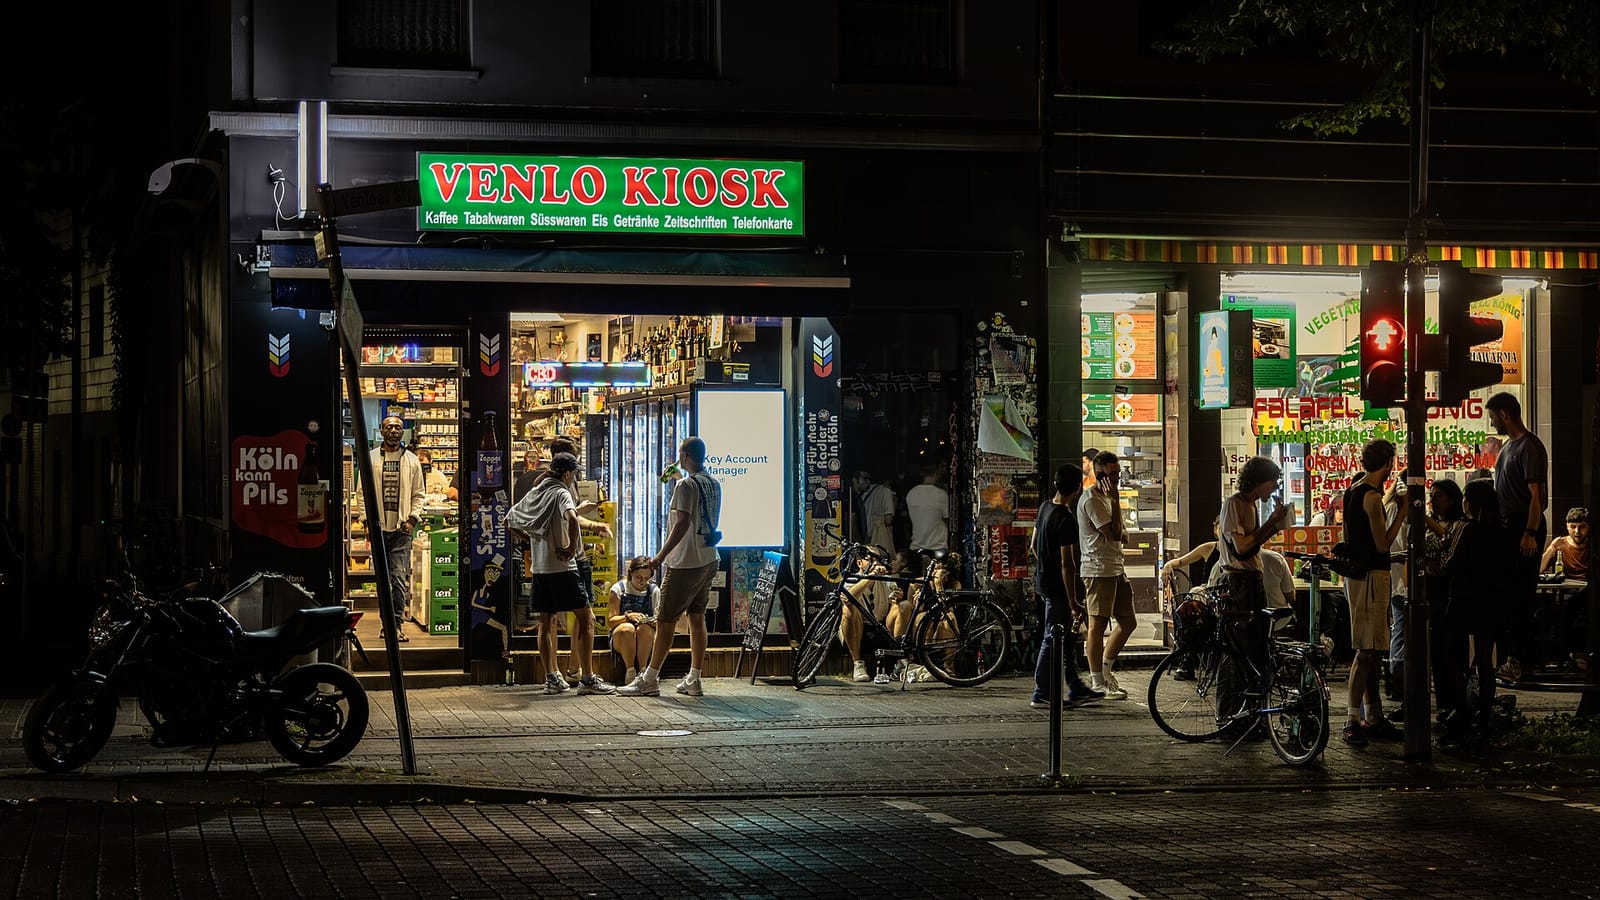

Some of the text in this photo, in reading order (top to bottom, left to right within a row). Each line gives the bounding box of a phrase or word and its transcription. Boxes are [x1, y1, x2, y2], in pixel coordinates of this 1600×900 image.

[429, 163, 788, 208] VENLO KIOSK
[425, 211, 793, 230] Kaffee Tabakwaren Süsswaren Eis Getränke Zeitschriften Telefonkarte
[1303, 299, 1361, 335] VEGETAR
[366, 343, 418, 363] open
[1470, 352, 1518, 364] HAWARMA
[1254, 391, 1483, 420] FALAFEL ÖNIG
[806, 411, 818, 443] mehr
[828, 415, 839, 457] in Köln
[1258, 425, 1487, 444] Libanesische Spelitäten
[240, 447, 298, 471] Köln
[725, 454, 768, 464] Account
[806, 446, 818, 465] Für
[817, 426, 828, 469] Radler
[703, 466, 748, 476] Manager
[1305, 454, 1363, 471] ORIGINA
[1453, 453, 1497, 470] POMM
[235, 468, 272, 481] kann
[243, 482, 289, 505] Pils
[476, 504, 497, 555] Sprt
[991, 527, 1001, 563] CRACK
[1000, 541, 1010, 577] CLOUD
